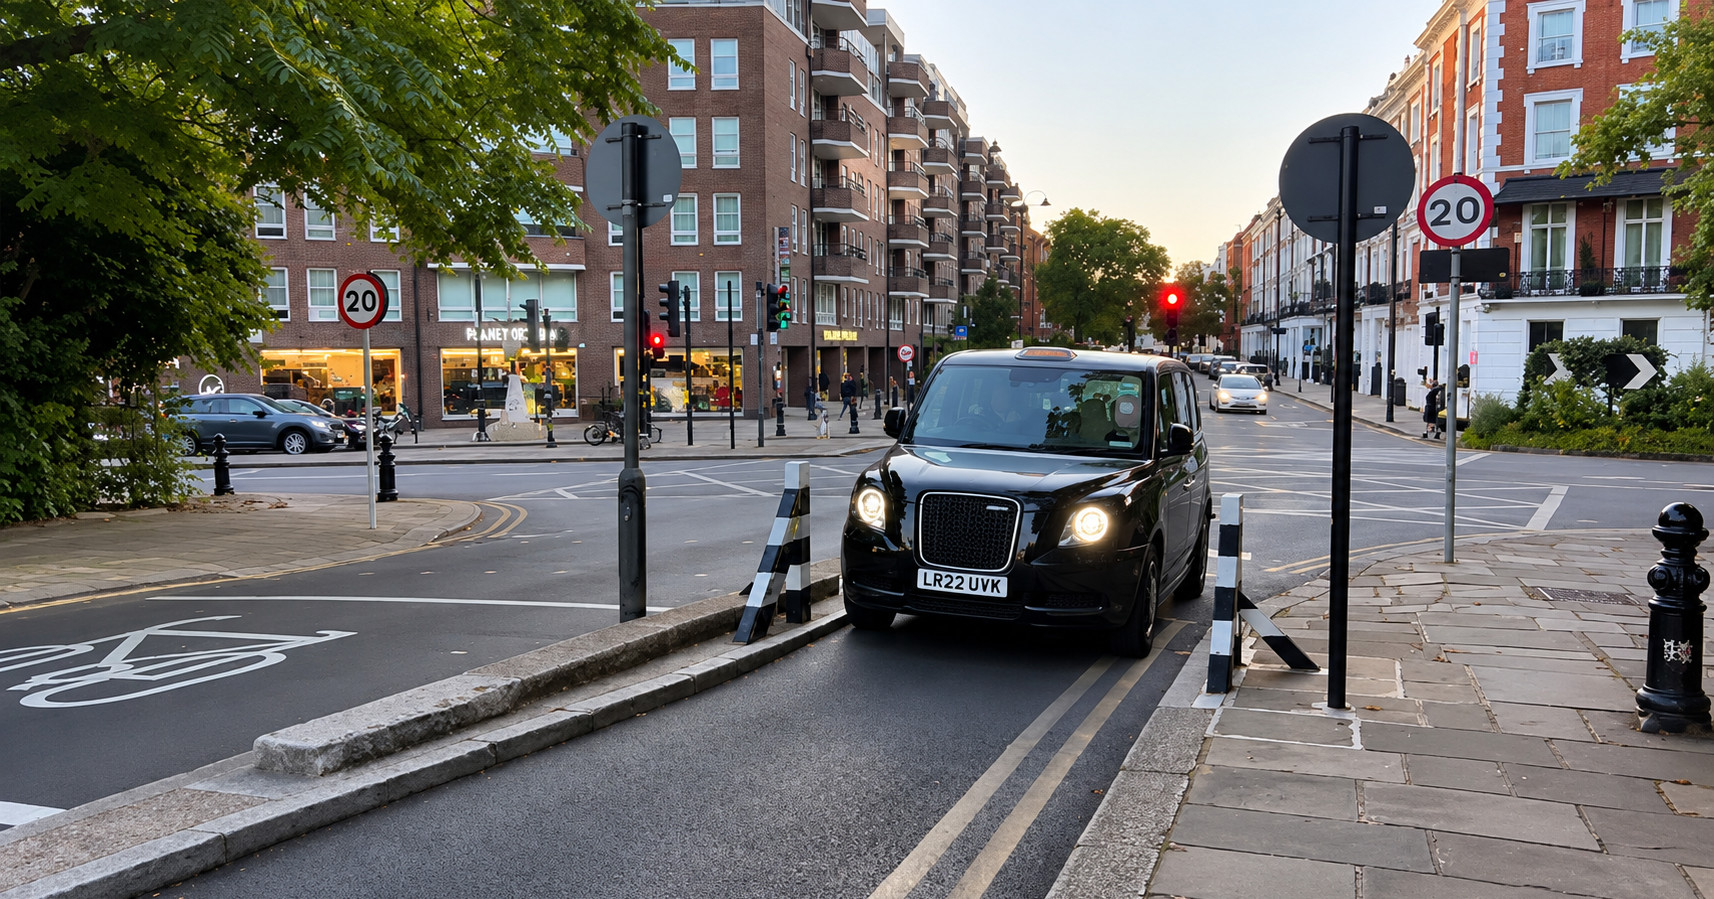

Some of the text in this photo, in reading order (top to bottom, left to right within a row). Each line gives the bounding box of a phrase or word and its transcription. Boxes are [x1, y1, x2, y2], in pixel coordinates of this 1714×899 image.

[1429, 196, 1480, 227] 20
[345, 289, 377, 313] 20
[922, 571, 1001, 594] LR22 UVK
